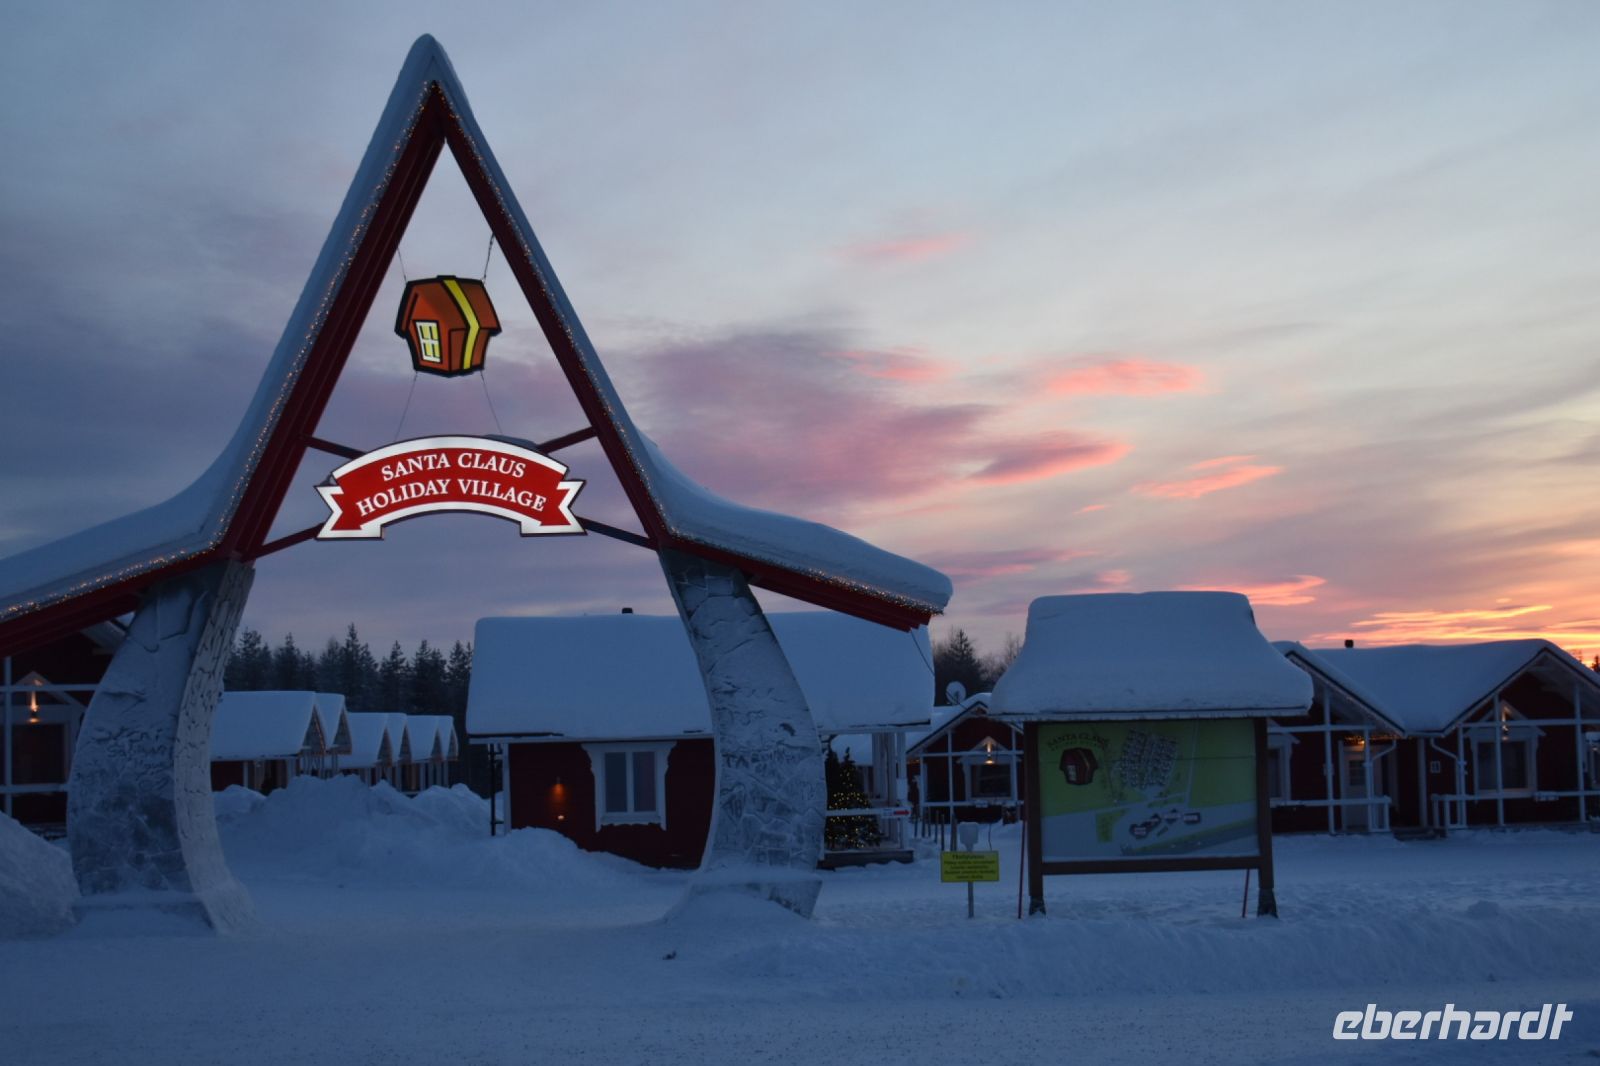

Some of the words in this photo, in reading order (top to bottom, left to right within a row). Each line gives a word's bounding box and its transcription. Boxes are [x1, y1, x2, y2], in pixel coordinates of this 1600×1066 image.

[380, 453, 452, 482] SANTA
[457, 452, 527, 478] CLAUS
[355, 478, 452, 517] HOLIDAY
[456, 478, 547, 512] VILLAGE
